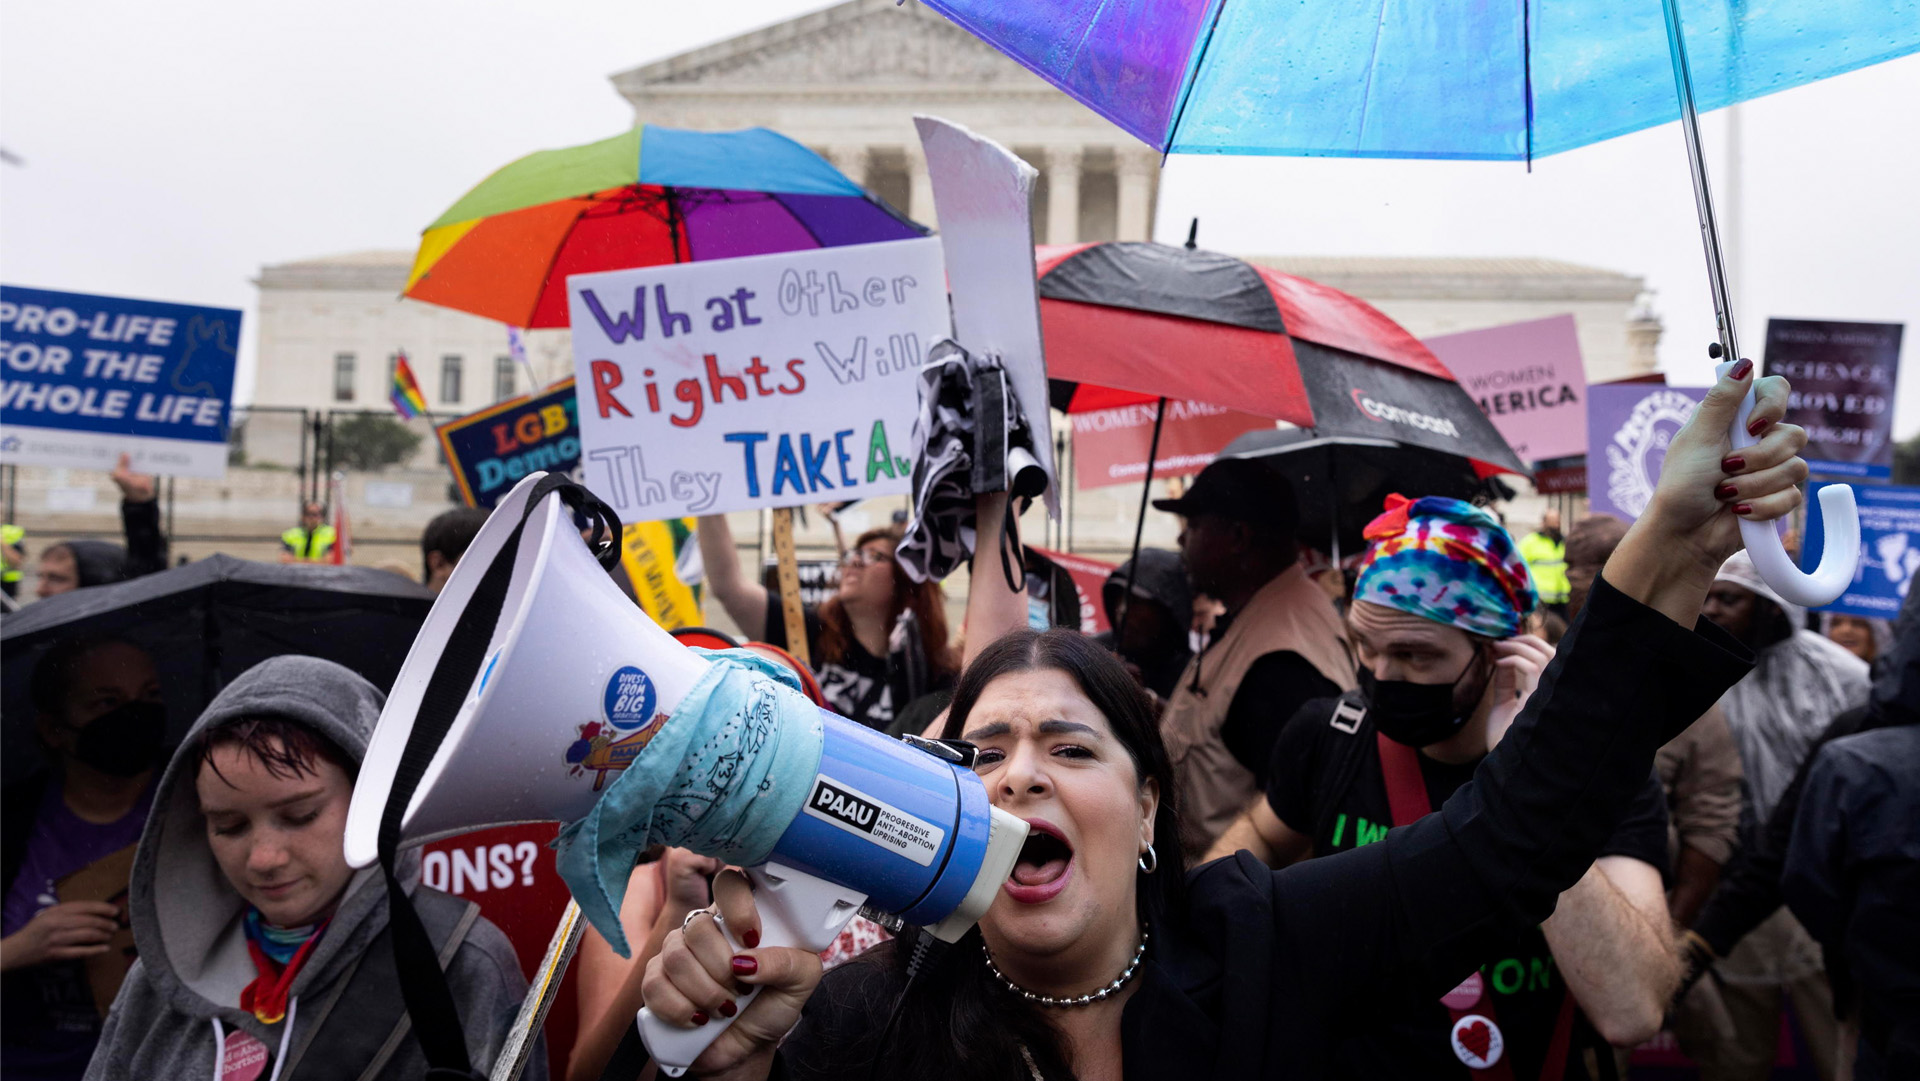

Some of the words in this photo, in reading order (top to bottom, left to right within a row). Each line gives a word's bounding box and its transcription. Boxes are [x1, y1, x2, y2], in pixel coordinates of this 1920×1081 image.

[579, 284, 762, 345] What
[778, 268, 917, 316] Other
[0, 302, 178, 347] PRO-LIFE
[82, 348, 165, 383] THE
[591, 354, 807, 428] Rights
[814, 333, 921, 385] Will
[135, 393, 224, 426] LIFE
[1787, 391, 1886, 414] ROVED
[475, 436, 582, 492] Demo
[589, 445, 721, 512] They
[723, 429, 858, 497] TAKE
[616, 684, 646, 696] FROM
[618, 673, 646, 684] DIVEST
[612, 694, 646, 713] BIG
[817, 787, 874, 826] PAAU
[873, 828, 908, 849] UPRISING
[877, 820, 936, 851] ANTI-ABORTION
[881, 810, 931, 839] PROGRESSIVE
[1331, 814, 1347, 847] I
[423, 841, 538, 895] ONS?
